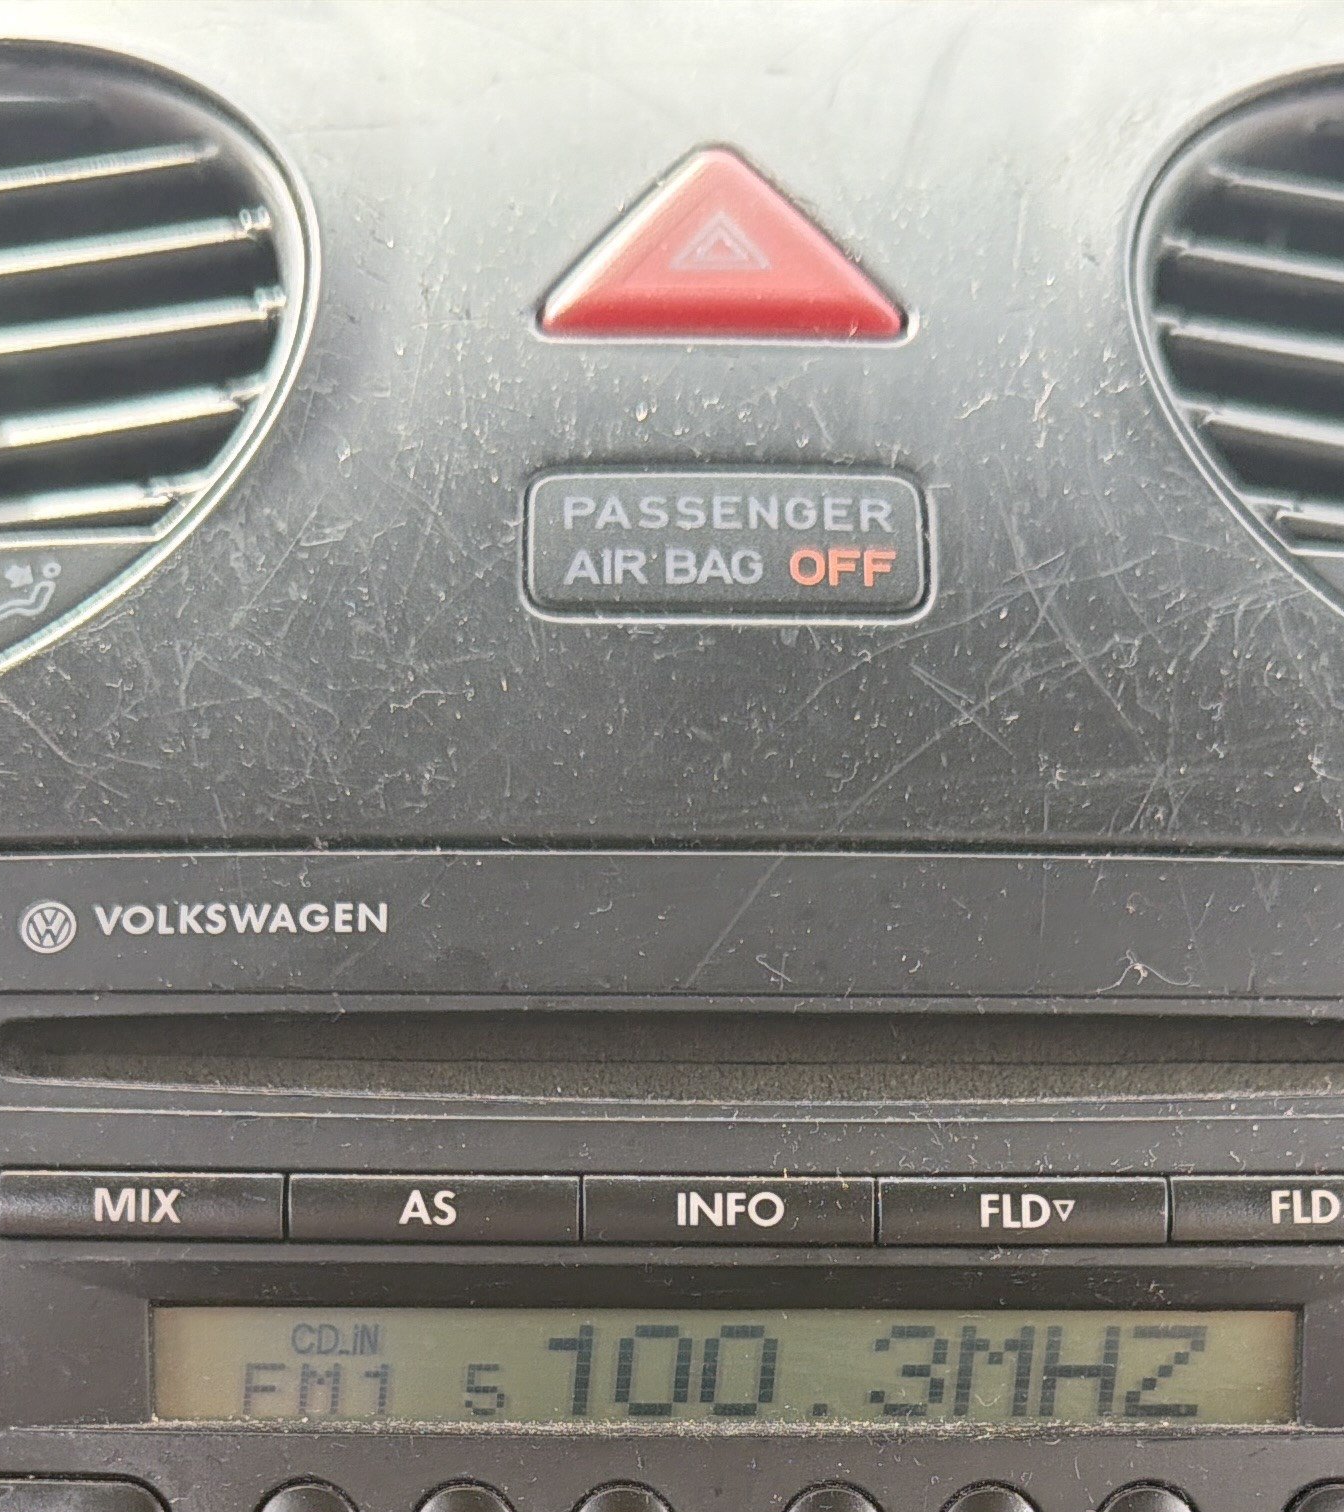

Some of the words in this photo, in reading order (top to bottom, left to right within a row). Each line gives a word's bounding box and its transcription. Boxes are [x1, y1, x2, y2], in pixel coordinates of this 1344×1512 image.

[563, 496, 896, 532] PASSENGER
[563, 548, 649, 585] AIR
[664, 548, 763, 585] BAG
[789, 548, 897, 587] OFF
[94, 903, 388, 936] VOLKSWAGEN
[93, 1188, 181, 1224] MIX
[399, 1190, 457, 1226] AS
[676, 1191, 785, 1228] INFO
[979, 1193, 1050, 1230] FLD
[1271, 1190, 1340, 1225] FLD
[243, 1362, 390, 1415] FM1
[464, 1363, 506, 1416] 5
